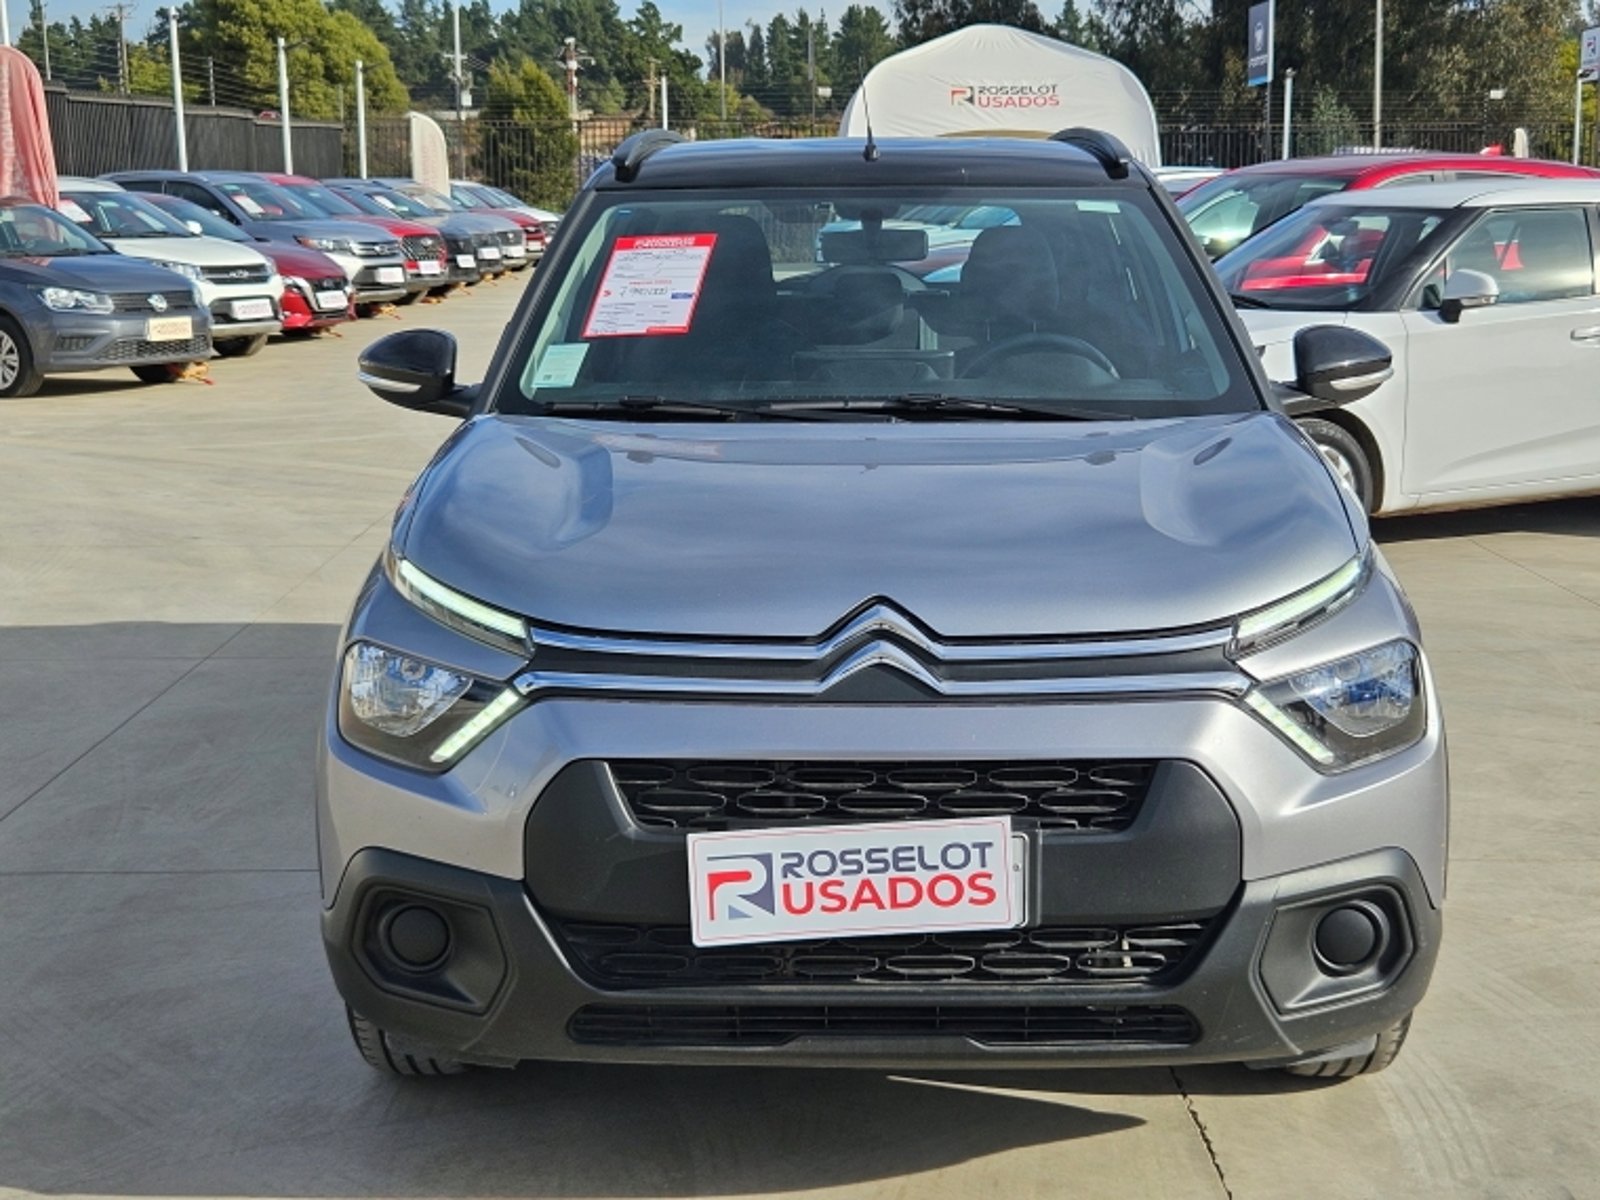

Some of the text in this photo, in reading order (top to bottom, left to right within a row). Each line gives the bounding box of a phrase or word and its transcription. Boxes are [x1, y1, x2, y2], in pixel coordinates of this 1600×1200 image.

[978, 84, 1058, 95] ROSSELOT
[978, 95, 1060, 108] USADOS
[781, 842, 994, 879] ROSSELOT
[782, 872, 997, 916] USADOS
